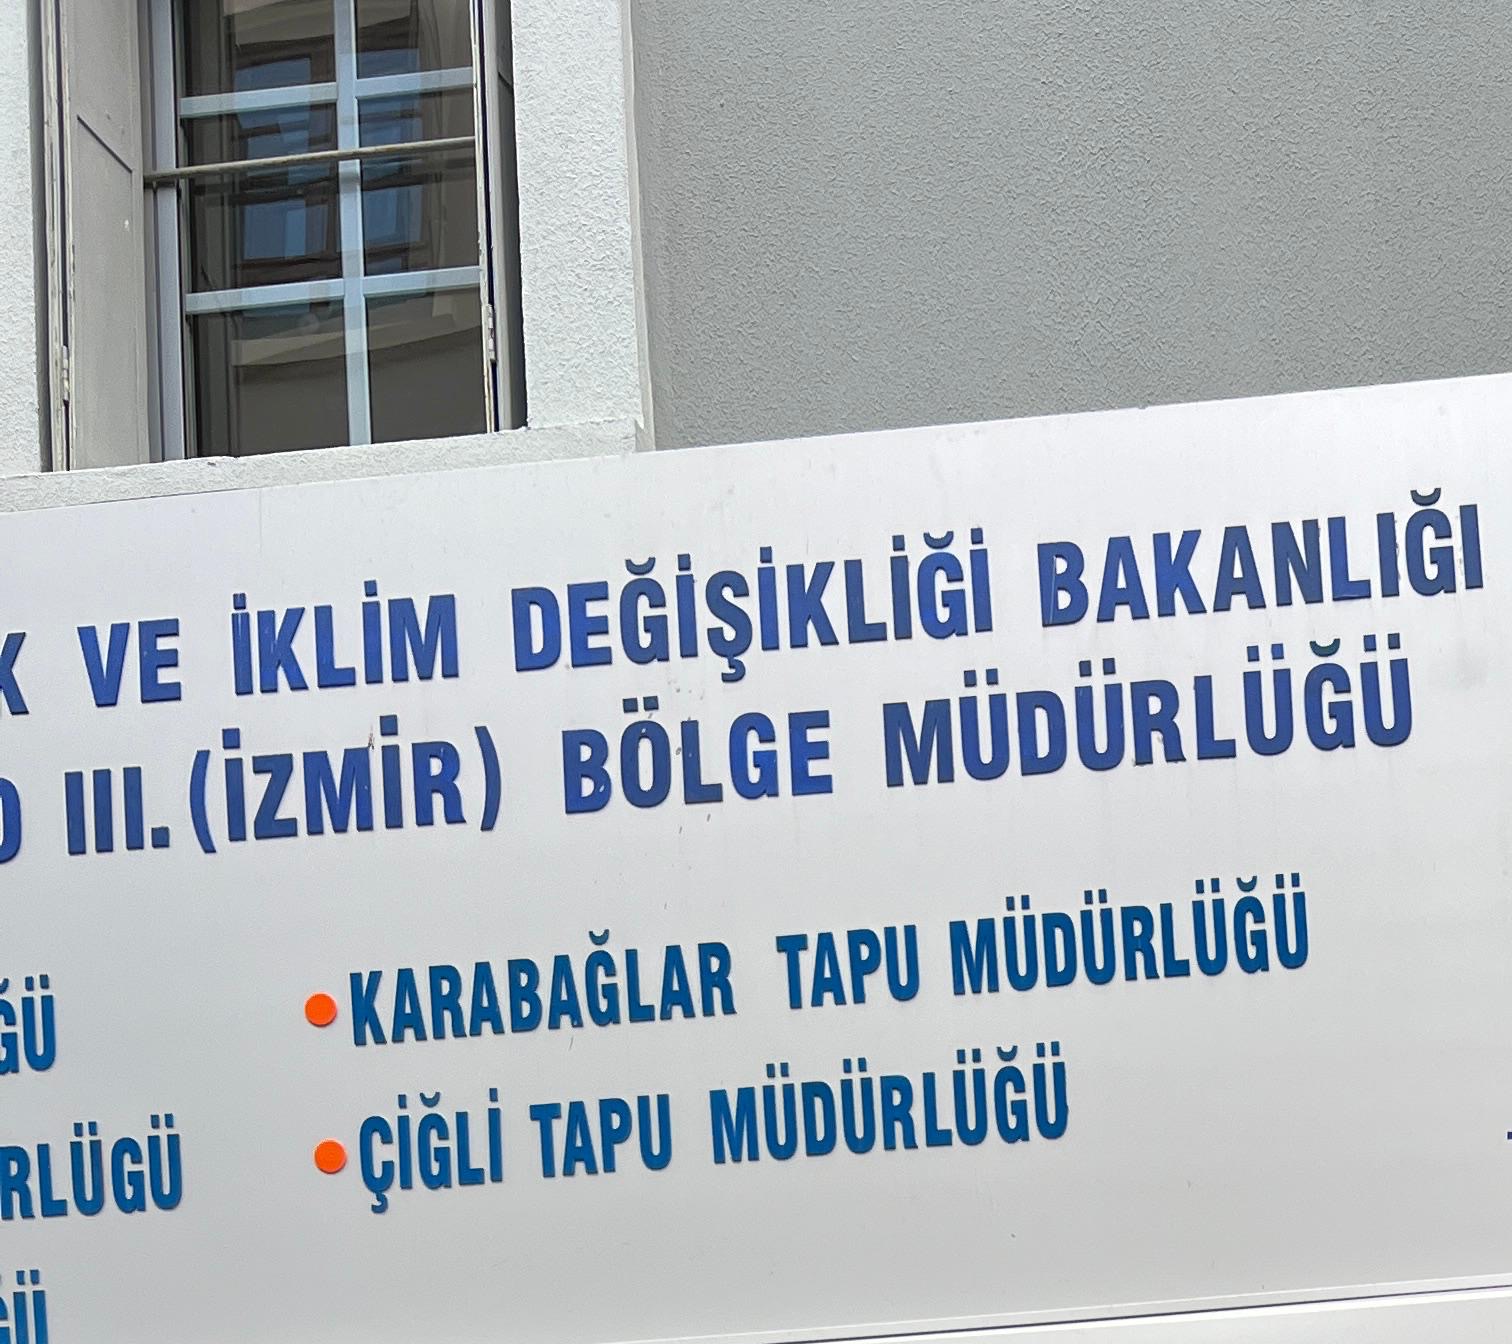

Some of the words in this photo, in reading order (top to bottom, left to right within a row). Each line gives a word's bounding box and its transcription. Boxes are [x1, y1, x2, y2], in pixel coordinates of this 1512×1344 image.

[77, 618, 182, 708] VE
[231, 579, 460, 697] İKLİM
[511, 527, 999, 684] DEĞİŞİKLİĞİ
[1037, 487, 1484, 626] BAKANLIĞI
[562, 697, 834, 815] BÖLGE
[882, 633, 1414, 787] MÜDÜRLÜĞÜ
[349, 929, 737, 1047] KARABAĞLAR
[775, 923, 921, 1010] TAPU
[948, 872, 1310, 997] MÜDÜRLÜĞÜ
[358, 1086, 504, 1215] ÇİĞLİ
[529, 1093, 674, 1179] TAPU
[709, 1040, 1070, 1165] MÜDÜRLÜĞÜ
